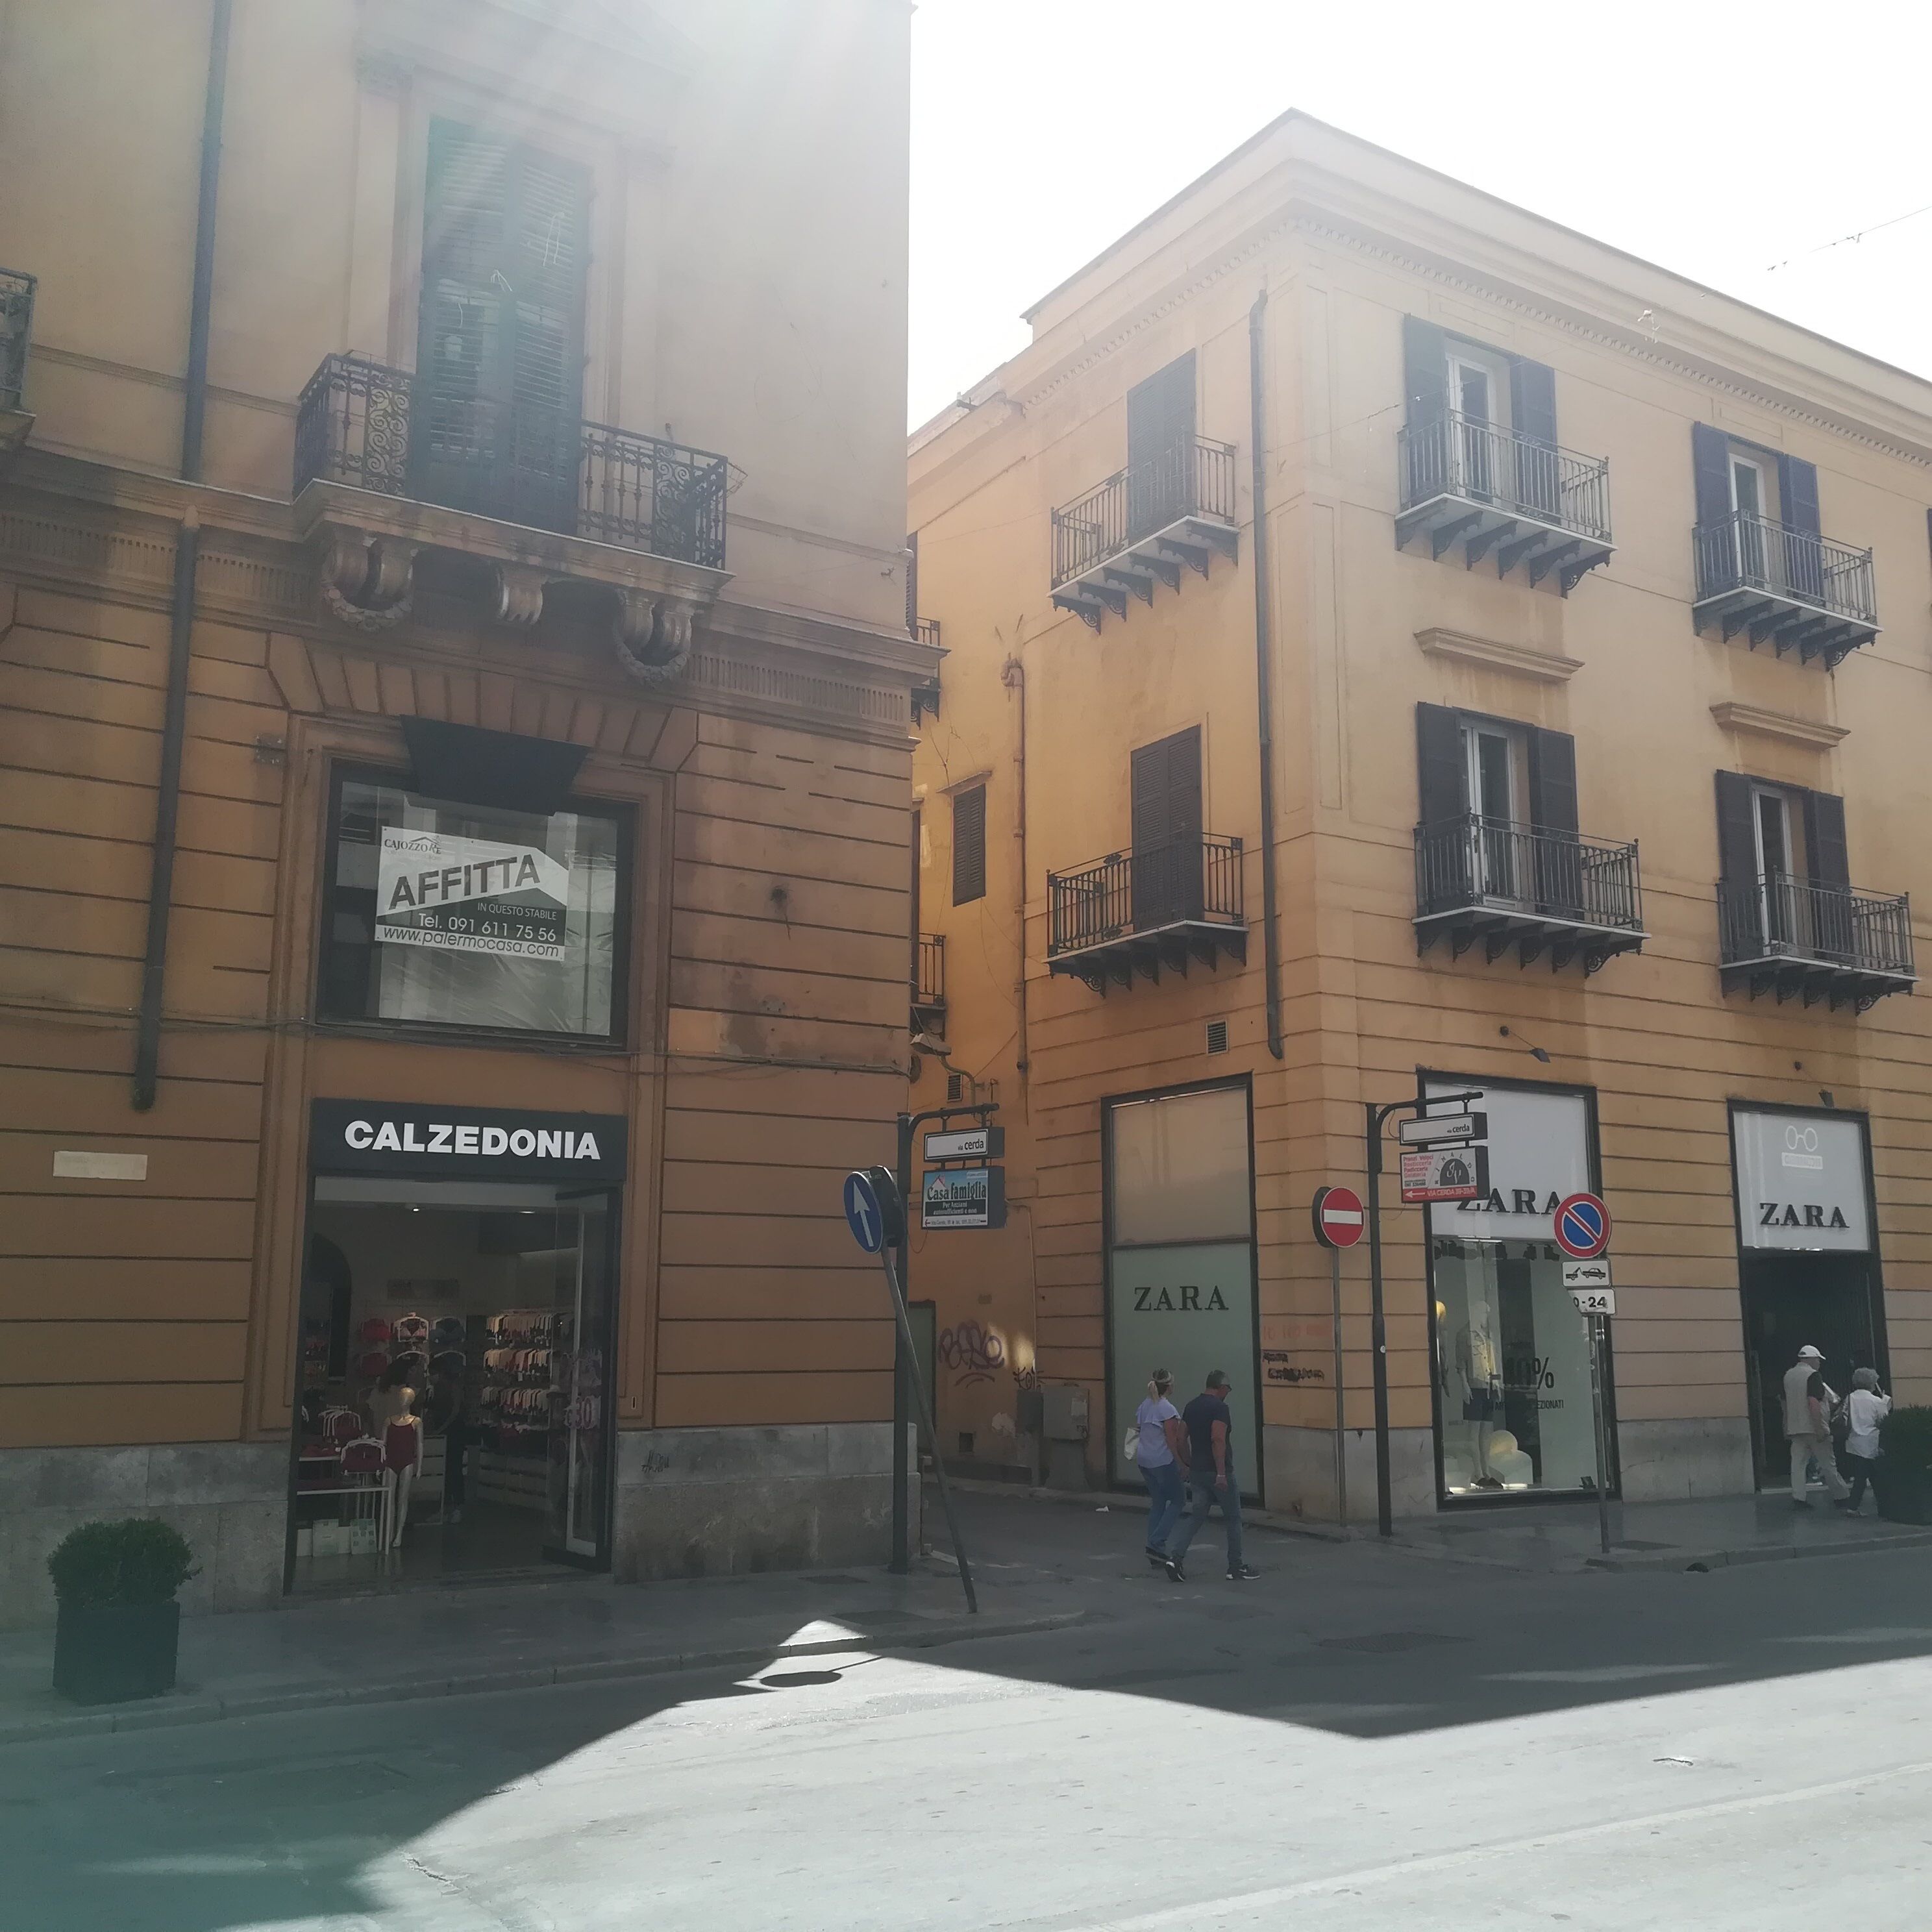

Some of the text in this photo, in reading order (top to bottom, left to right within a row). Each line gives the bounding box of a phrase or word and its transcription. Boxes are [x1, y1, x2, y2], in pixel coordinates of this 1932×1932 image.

[388, 854, 540, 910] AFFITTA
[477, 902, 557, 921] IN QUESTO STABILE
[419, 913, 556, 942] Tel. 091 611 75 56
[384, 926, 559, 958] www.palermocasa.com
[345, 1121, 601, 1159] CALZEDONIA
[1452, 1124, 1470, 1133] cerda
[964, 1139, 984, 1150] cerda
[927, 1182, 987, 1201] Casa famiglia
[1760, 1203, 1850, 1228] ZARA
[1133, 1285, 1229, 1311] ZARA
[1537, 1399, 1565, 1409] EZIONATI
